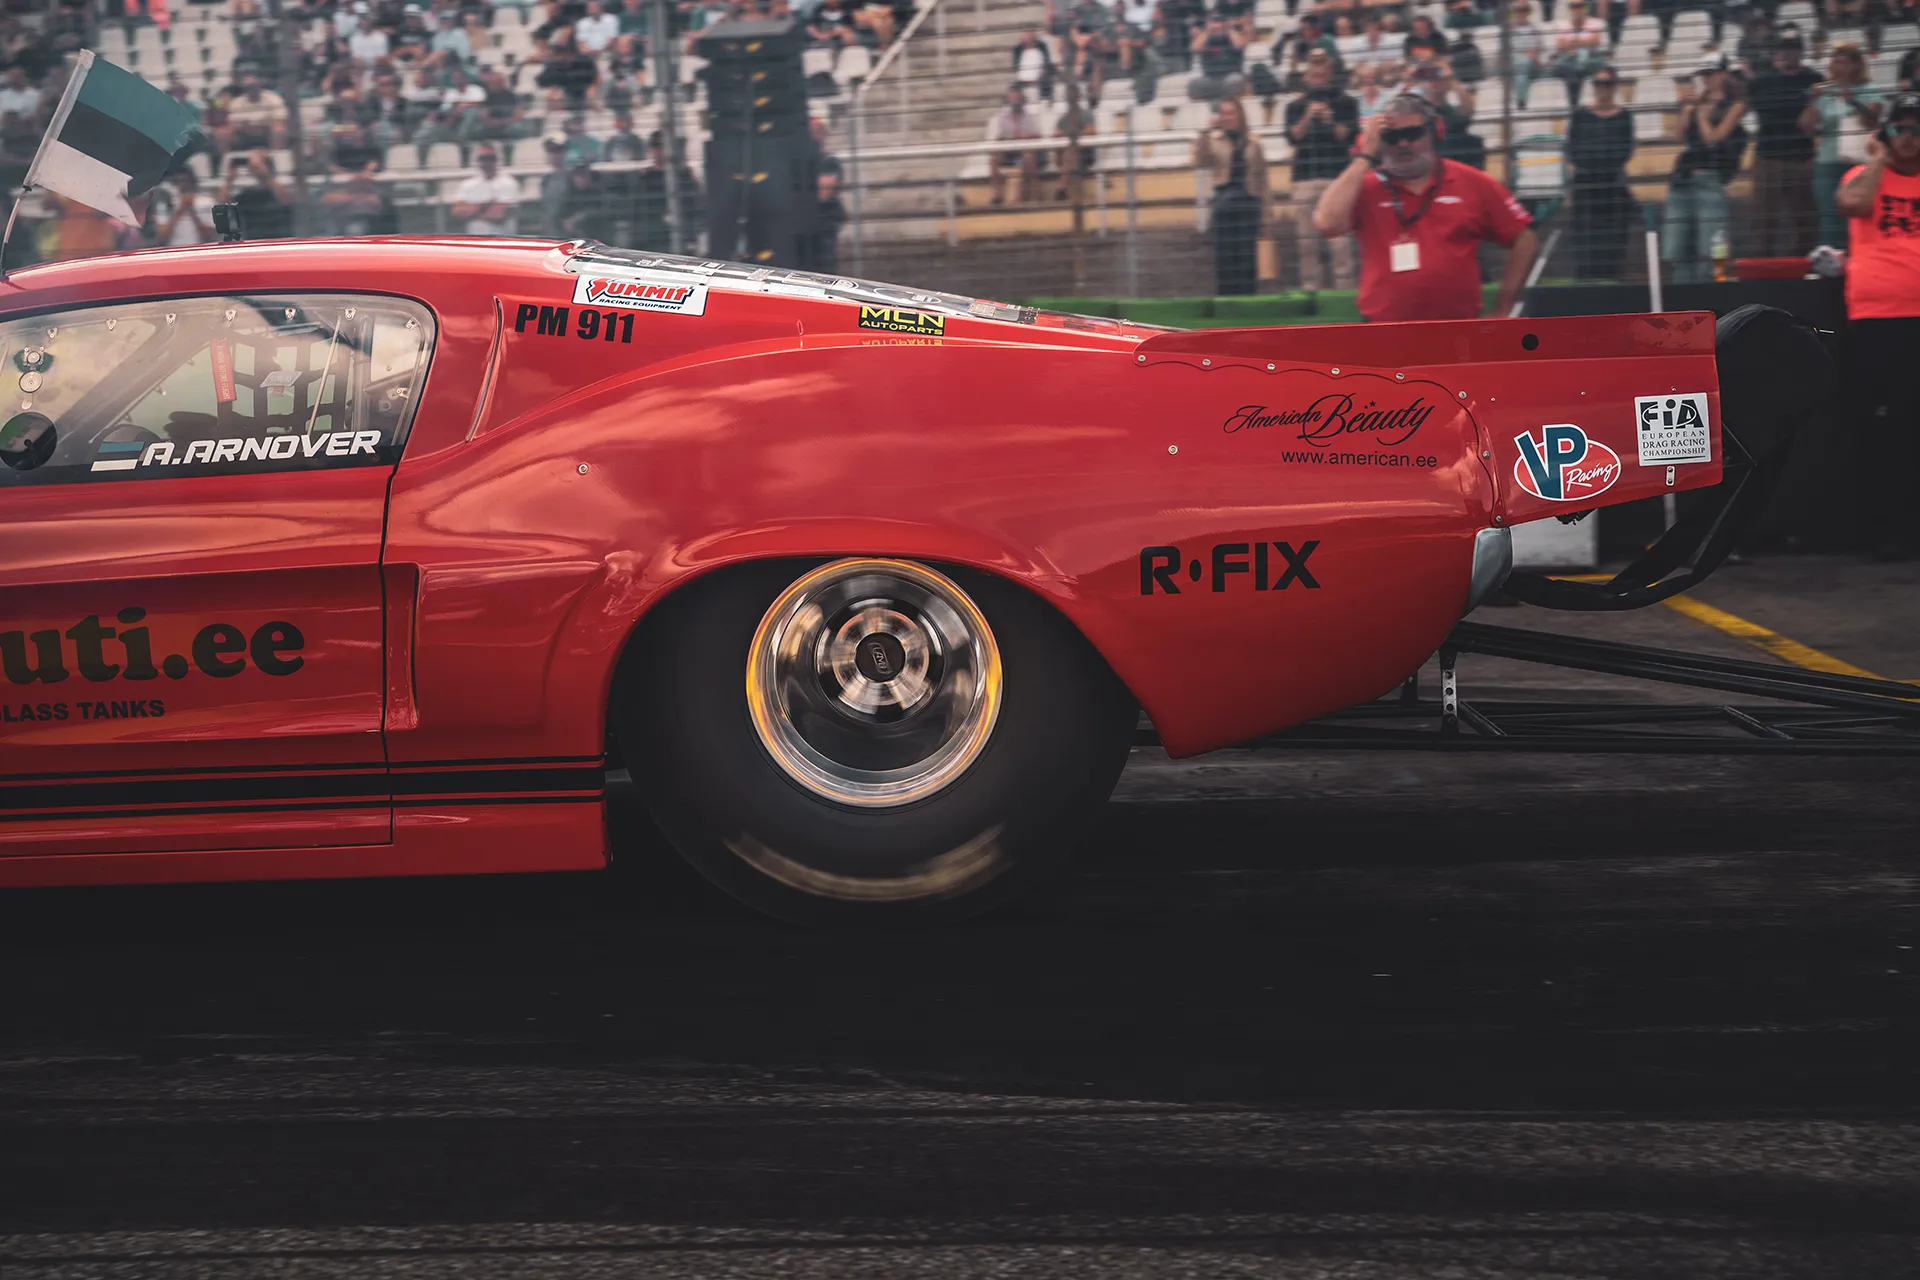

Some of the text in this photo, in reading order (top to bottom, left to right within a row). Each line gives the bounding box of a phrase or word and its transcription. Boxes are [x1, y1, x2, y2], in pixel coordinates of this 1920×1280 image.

[589, 277, 690, 301] SUMMIT
[599, 298, 682, 310] RACING EQUIPMENT
[860, 304, 944, 328] MCN
[514, 303, 635, 344] PM 911
[861, 320, 943, 336] AUTOPARTS
[1223, 392, 1435, 447] American Beauty
[1641, 429, 1705, 440] EUROPEAN
[1642, 438, 1705, 449] DRAG RACING
[142, 430, 381, 466] A.ARNOVER
[1281, 450, 1438, 468] www.american.ee
[1642, 447, 1706, 457] CHAMPIONSHIP
[1514, 424, 1589, 500] VP
[1565, 463, 1618, 492] Racing
[0, 606, 305, 685] uti.ee
[0, 700, 165, 722] LASS TANKS
